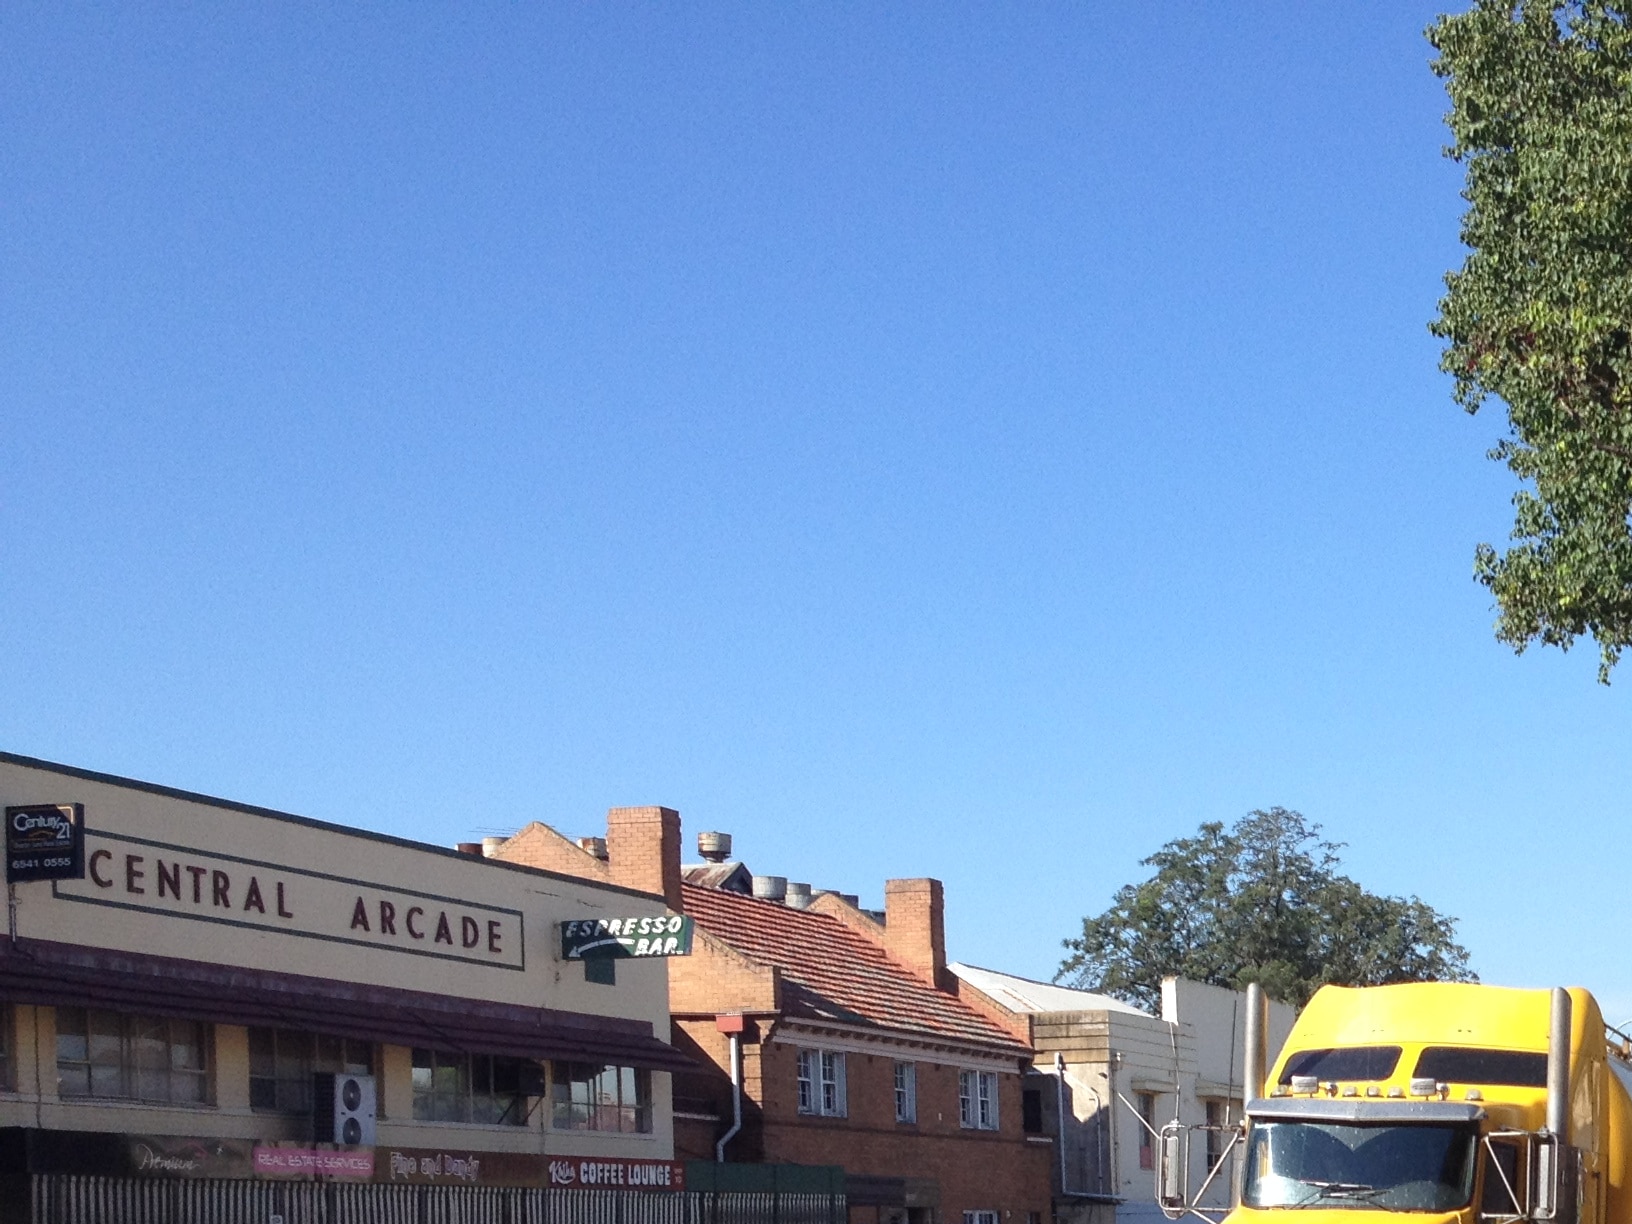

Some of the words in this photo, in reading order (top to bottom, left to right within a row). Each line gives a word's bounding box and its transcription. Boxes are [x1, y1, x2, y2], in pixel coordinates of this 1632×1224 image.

[13, 813, 61, 831] Century
[56, 822, 70, 839] 21
[12, 860, 39, 869] 6541
[43, 857, 71, 867] 0555
[89, 850, 293, 918] CENTRAL
[350, 896, 501, 952] ARCADE
[565, 916, 682, 938] ESPRESSO
[258, 1154, 286, 1166] REAL
[288, 1154, 322, 1168] ESTATE
[324, 1156, 371, 1170] SERVICES
[580, 1162, 624, 1185] COFFEE
[628, 1163, 670, 1186] LOUNGE
